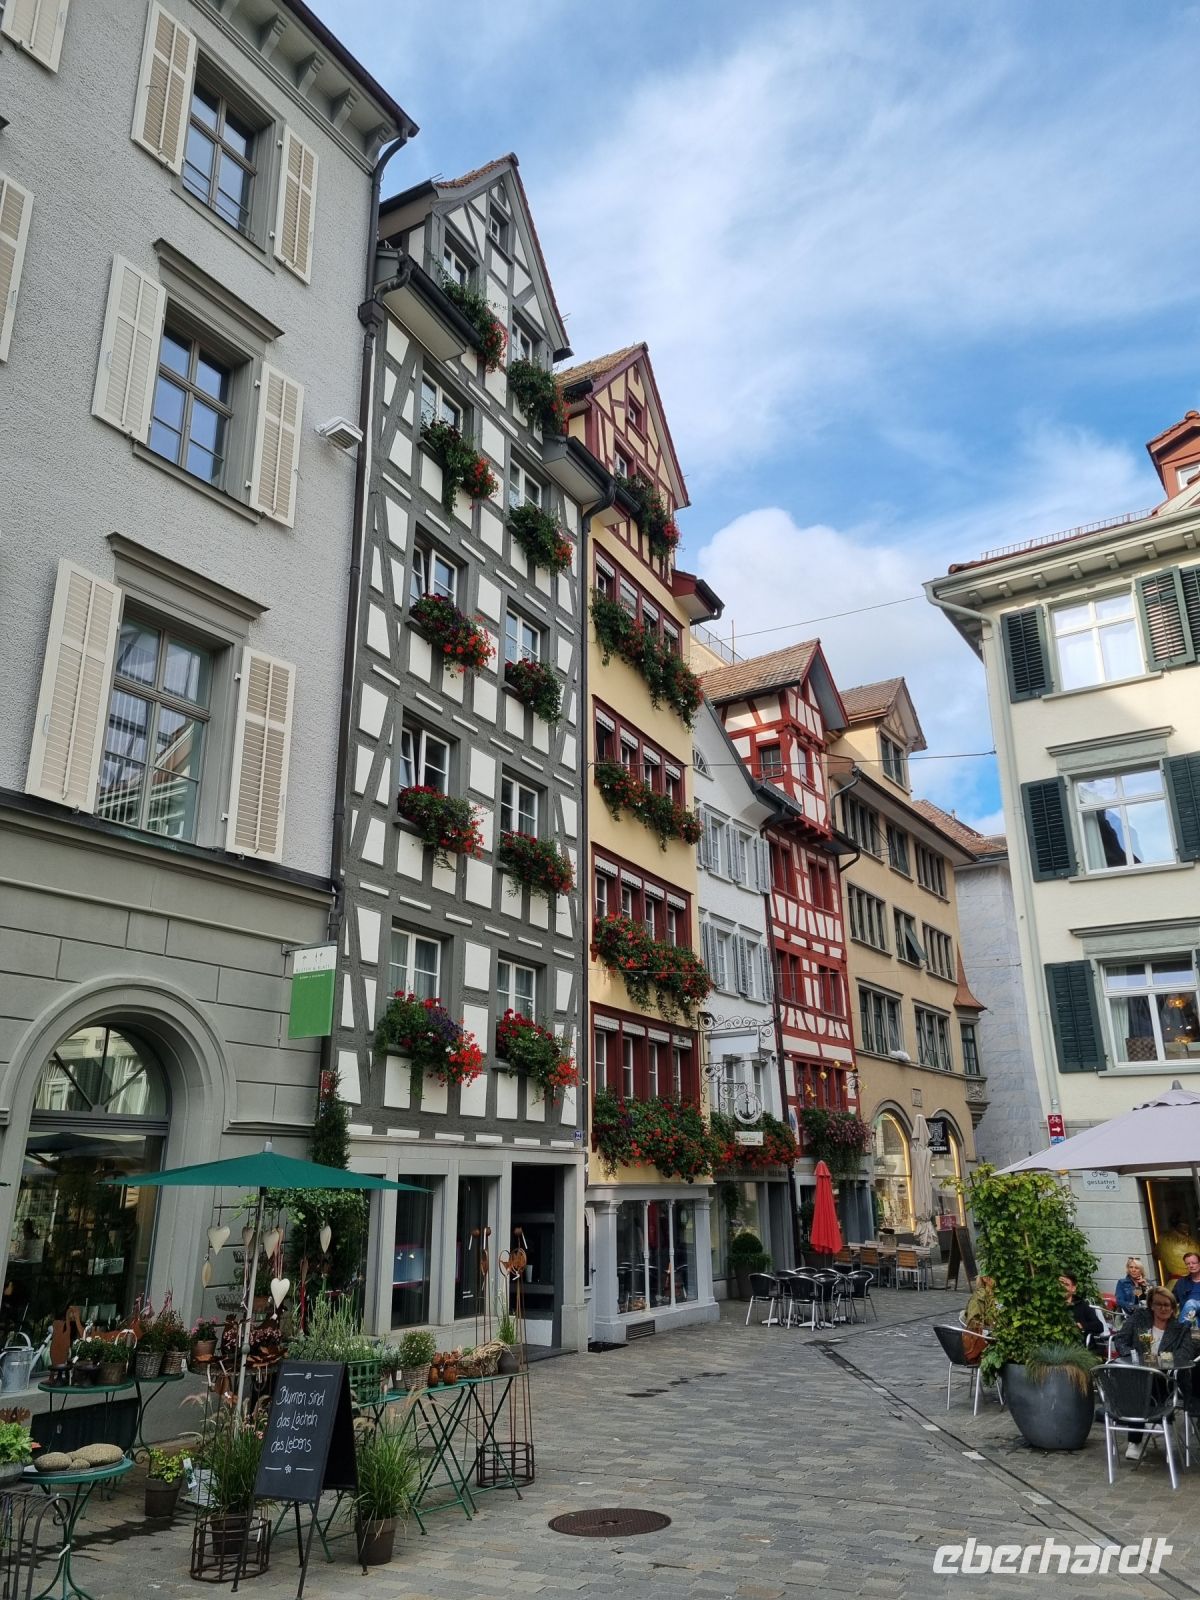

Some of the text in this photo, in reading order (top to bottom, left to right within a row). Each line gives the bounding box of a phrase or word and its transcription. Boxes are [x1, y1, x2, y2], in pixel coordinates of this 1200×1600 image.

[276, 1385, 326, 1406] Blumen sind
[276, 1411, 291, 1428] das
[271, 1435, 312, 1454] des Lebens
